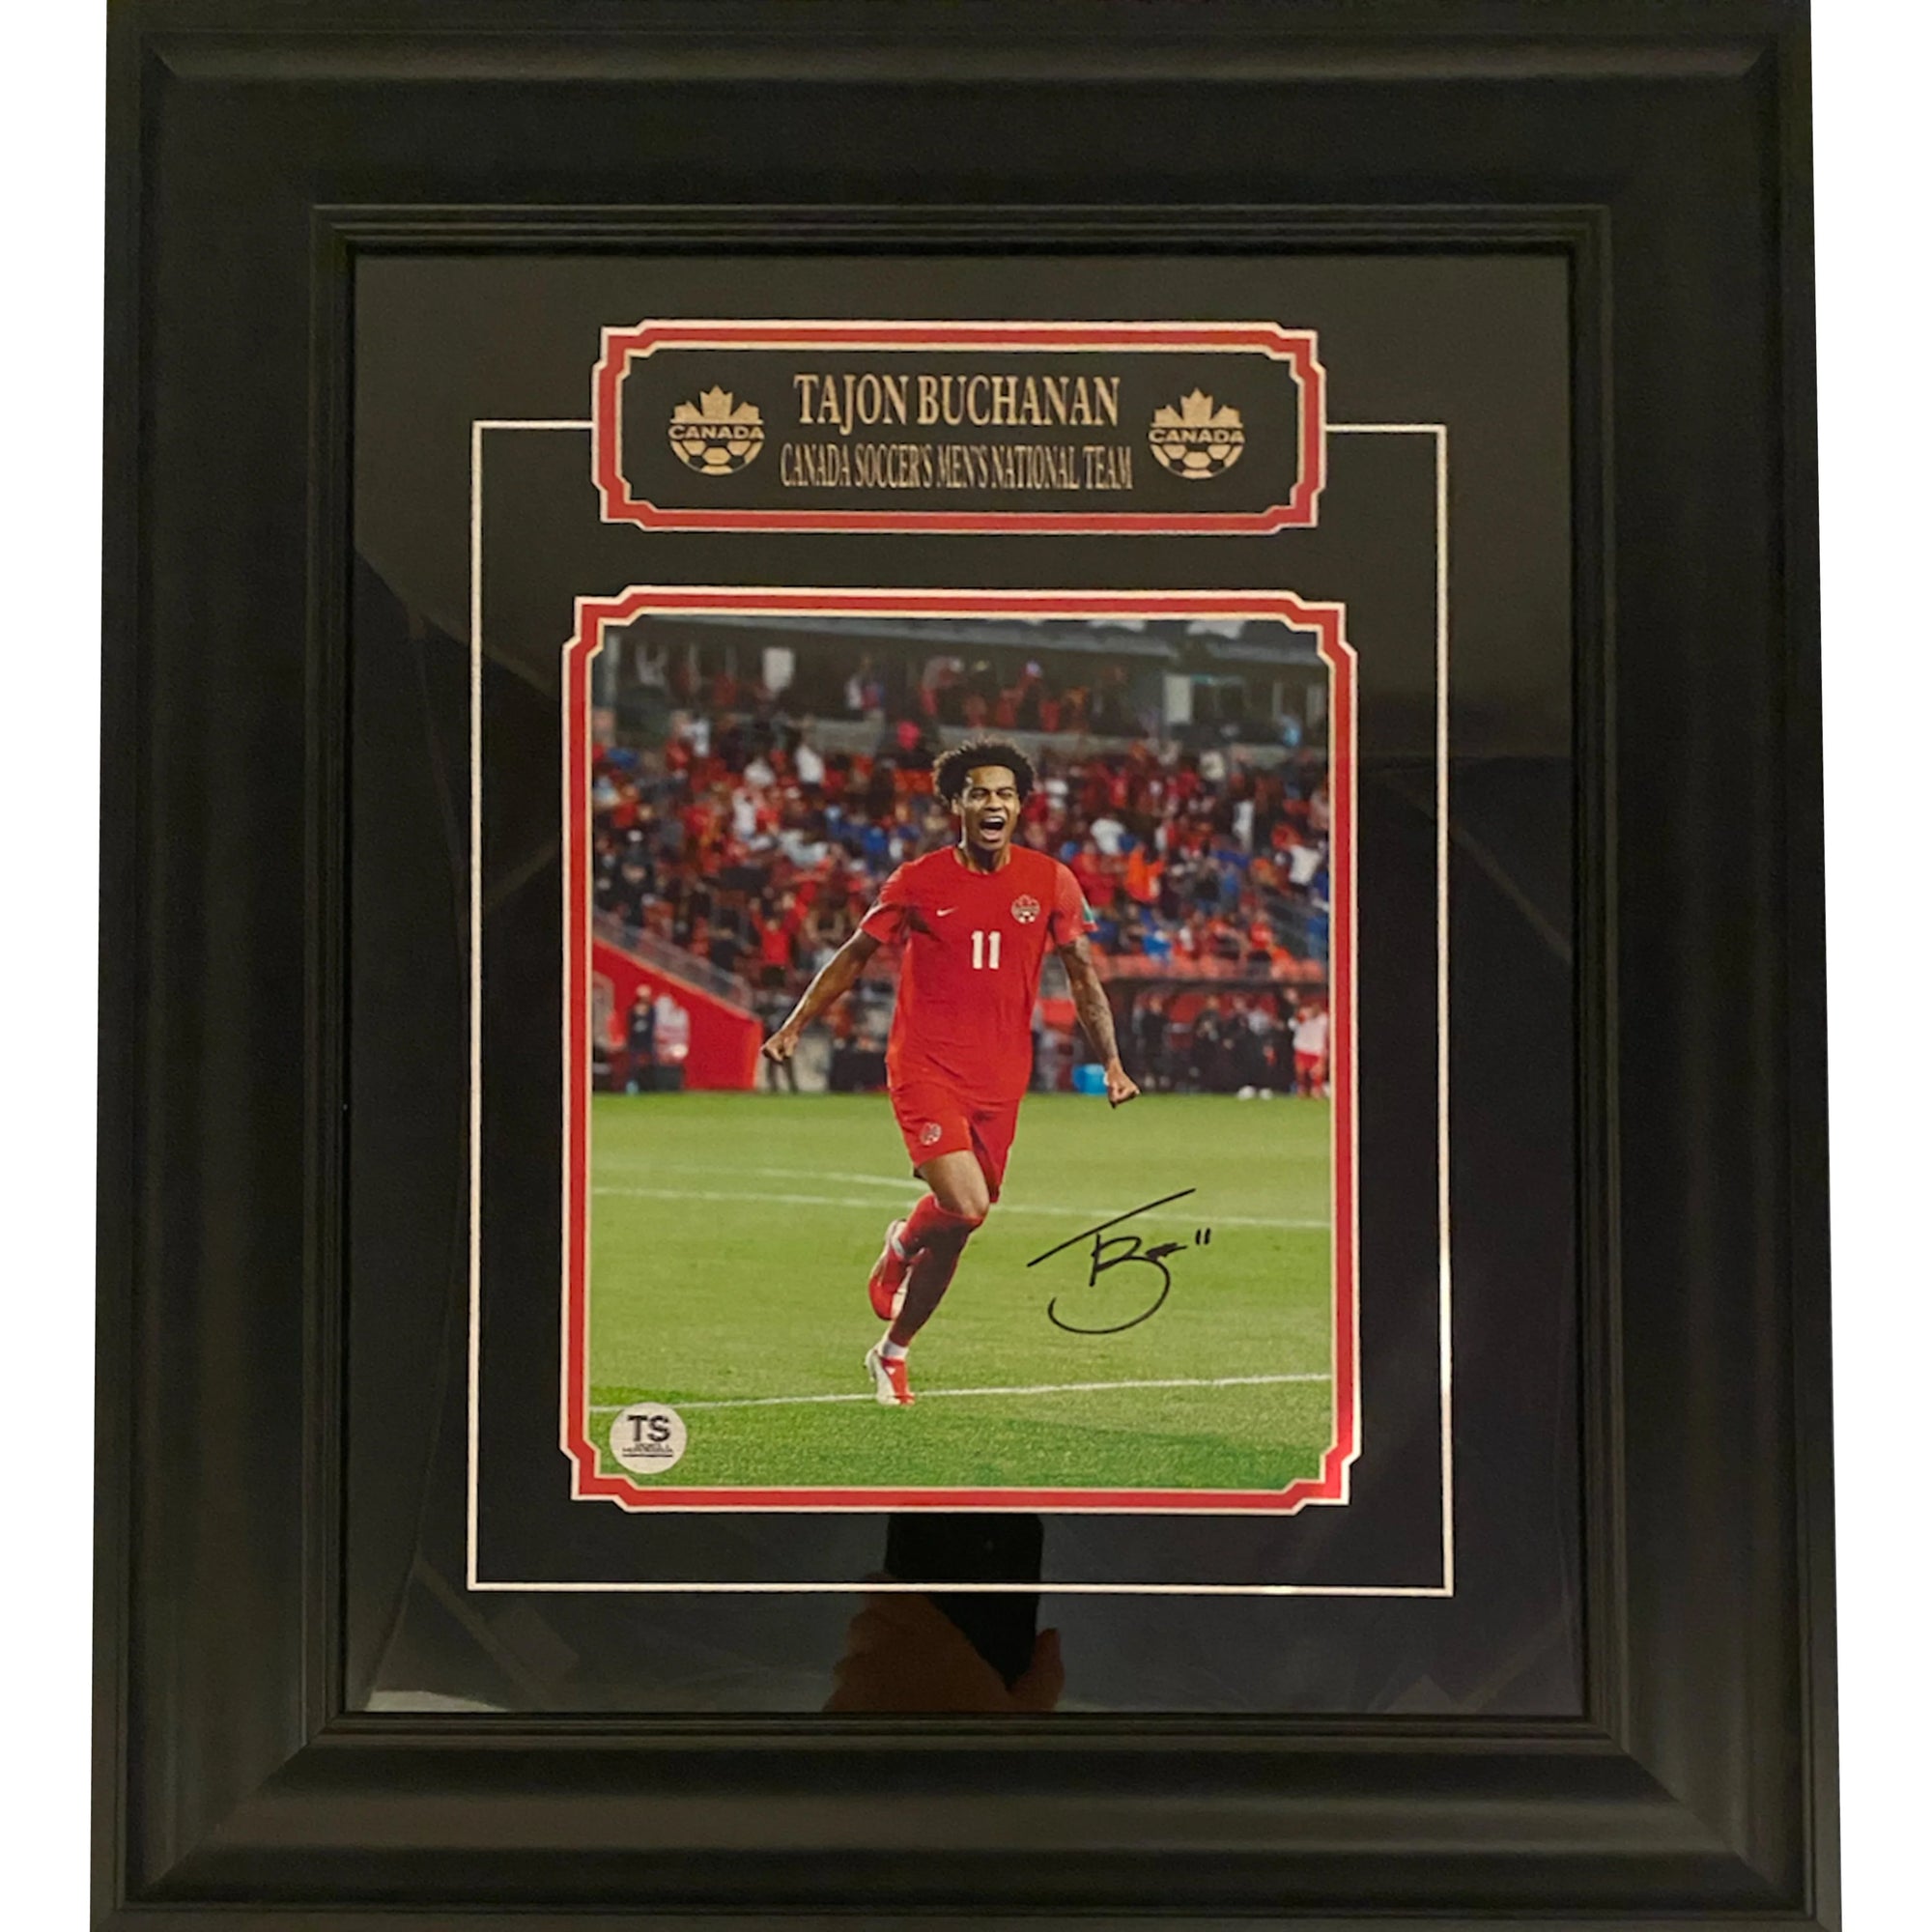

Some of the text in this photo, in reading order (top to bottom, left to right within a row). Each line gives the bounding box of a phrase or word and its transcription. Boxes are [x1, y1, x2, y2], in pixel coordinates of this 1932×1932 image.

[793, 374, 1121, 436] TAJON BUCHANAN
[668, 425, 765, 440] CANADA
[1148, 429, 1242, 443] CANADA
[781, 442, 852, 487] CANADA
[990, 444, 1080, 490] NATIONAL
[1083, 444, 1134, 490] TEAM
[972, 930, 1001, 970] 11
[627, 1414, 670, 1442] TS
